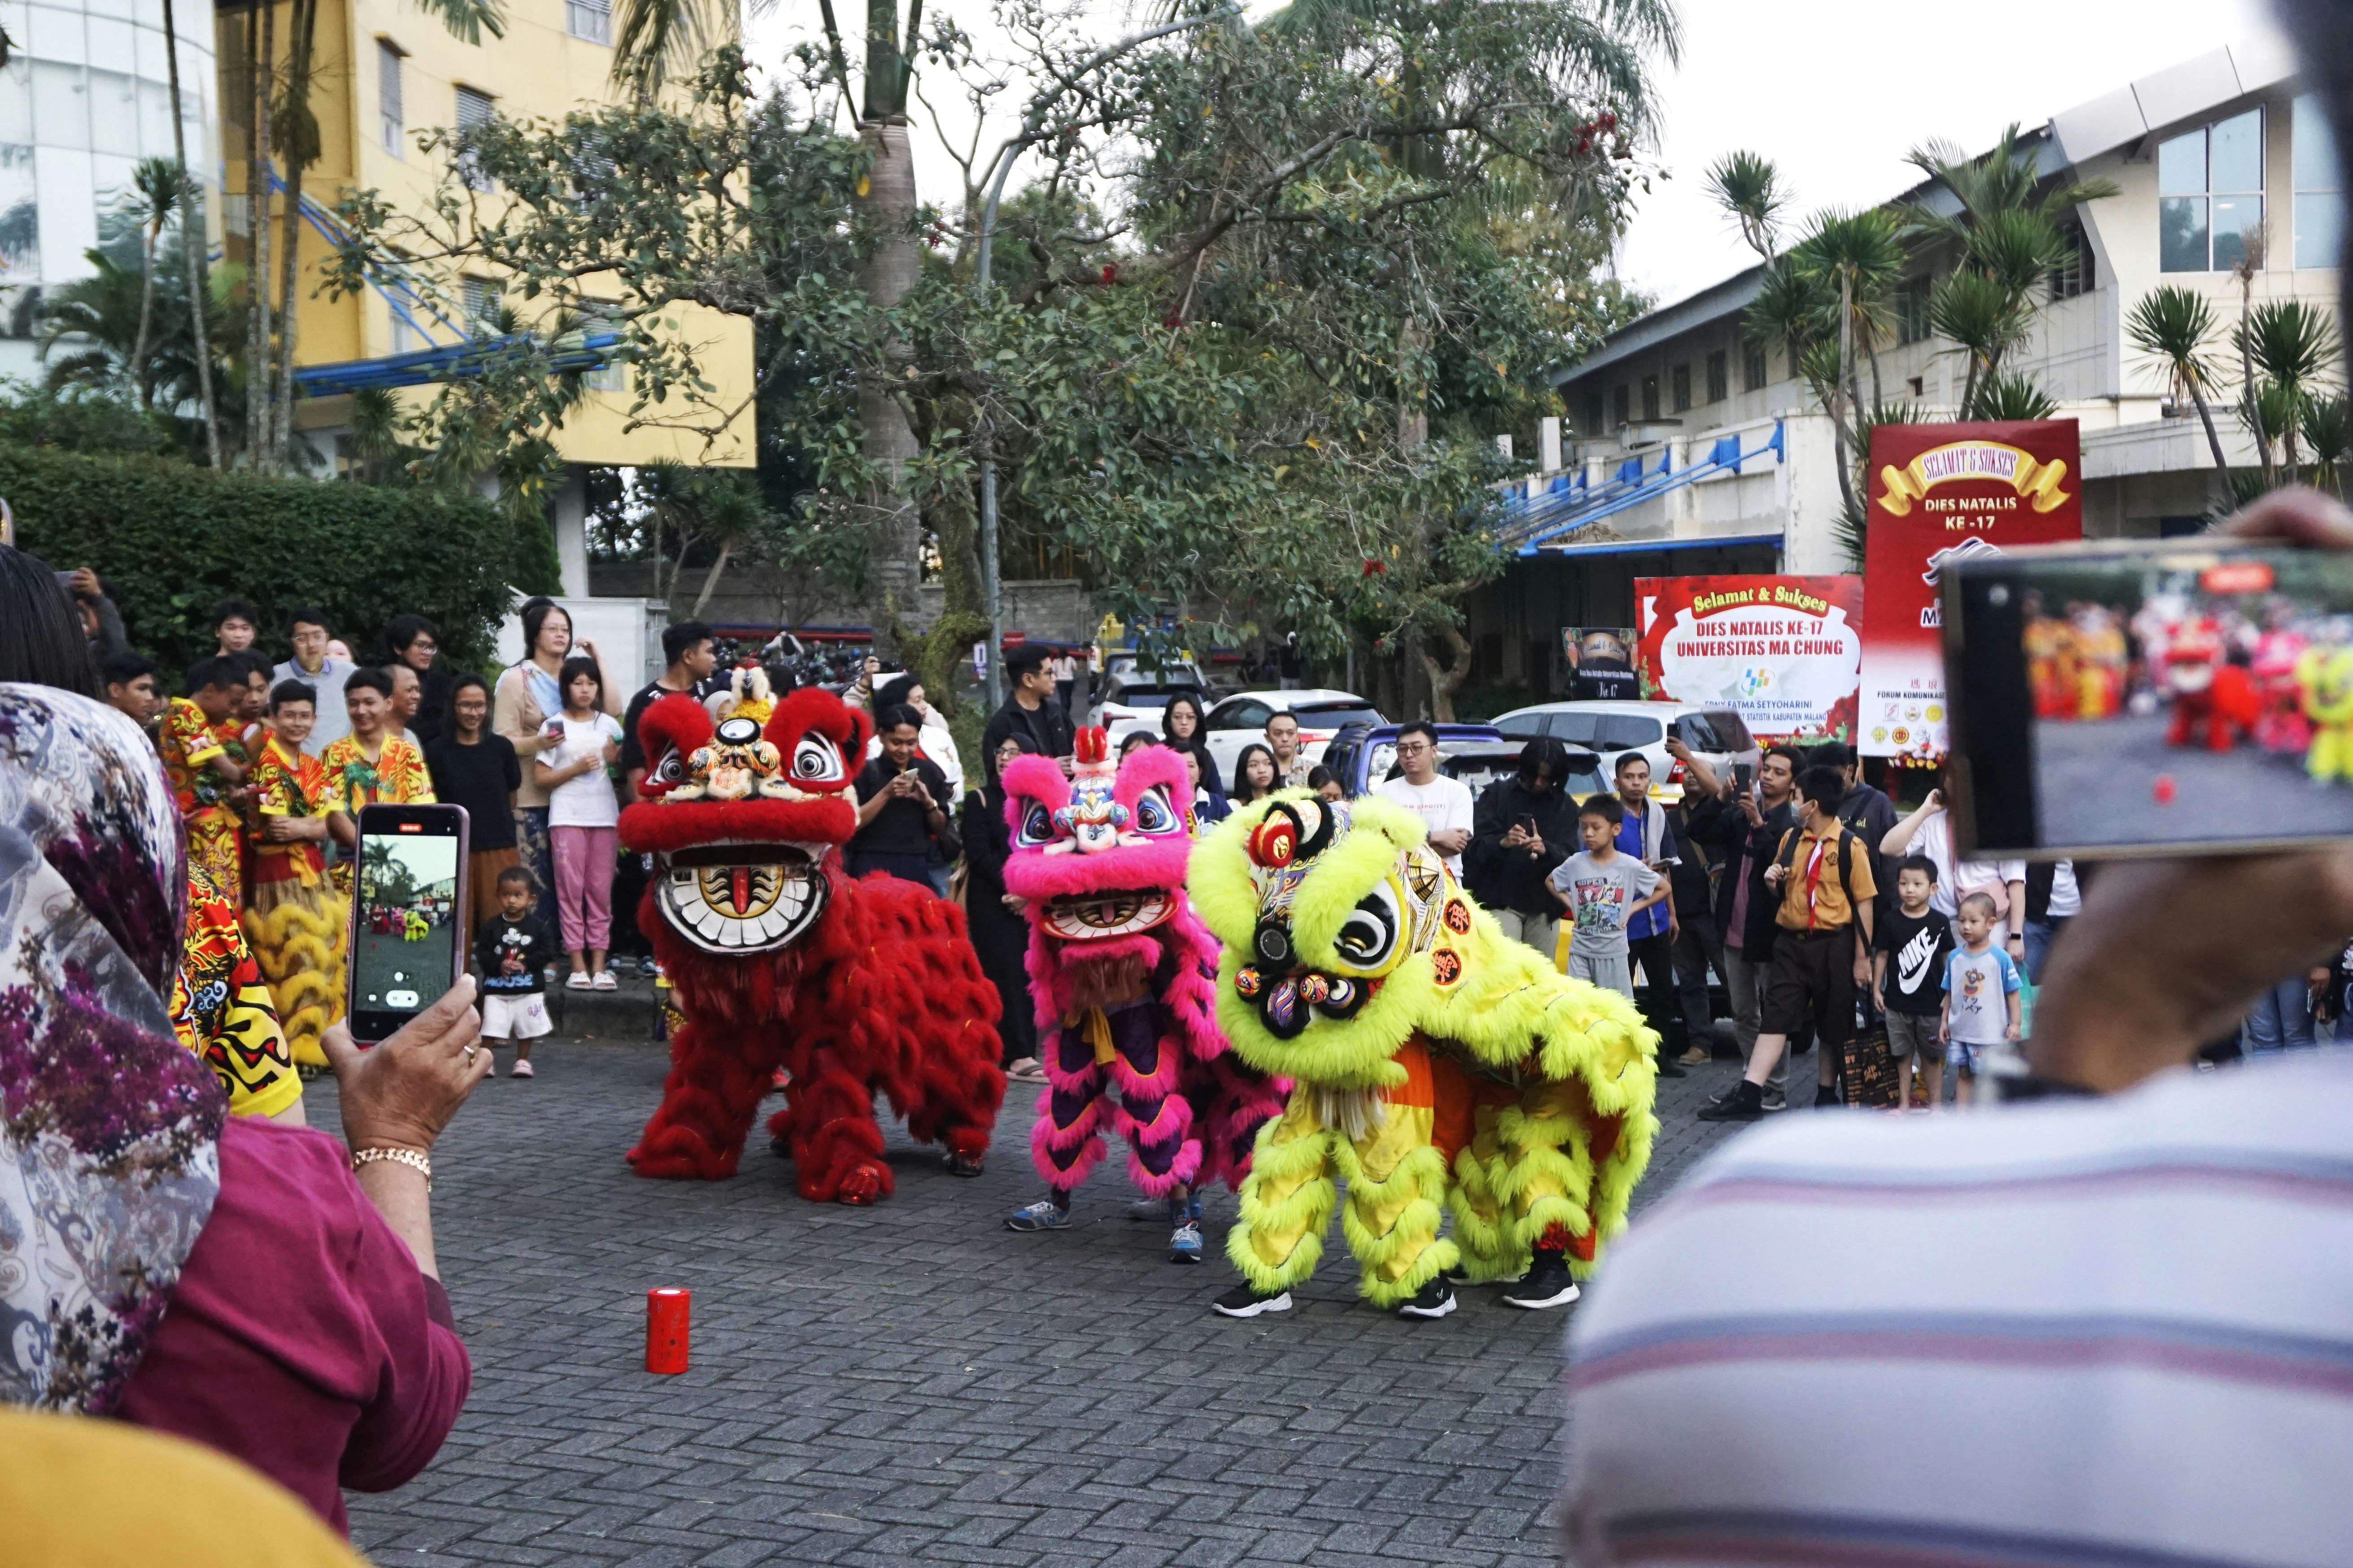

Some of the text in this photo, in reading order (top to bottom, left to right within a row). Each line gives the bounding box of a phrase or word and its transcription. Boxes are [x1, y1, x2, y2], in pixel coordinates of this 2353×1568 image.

[1924, 449, 1967, 480] SELAMAT
[1979, 448, 2016, 477] SUKSES
[1925, 497, 2016, 512] DIES NATALIS
[1945, 515, 1964, 530] KE
[1693, 585, 1827, 613] Selamat & Sukses
[1697, 620, 1824, 636] DIES NATALIS KE-17
[1677, 639, 1843, 657] UNIVERSITAS MA CHUNG
[1728, 700, 1755, 709] FATMA
[1757, 700, 1812, 709] SETYOHARINI
[1747, 712, 1771, 721] STATISTIK
[1773, 712, 1802, 721] KABUPATEN
[1898, 927, 1931, 975] NIKE
